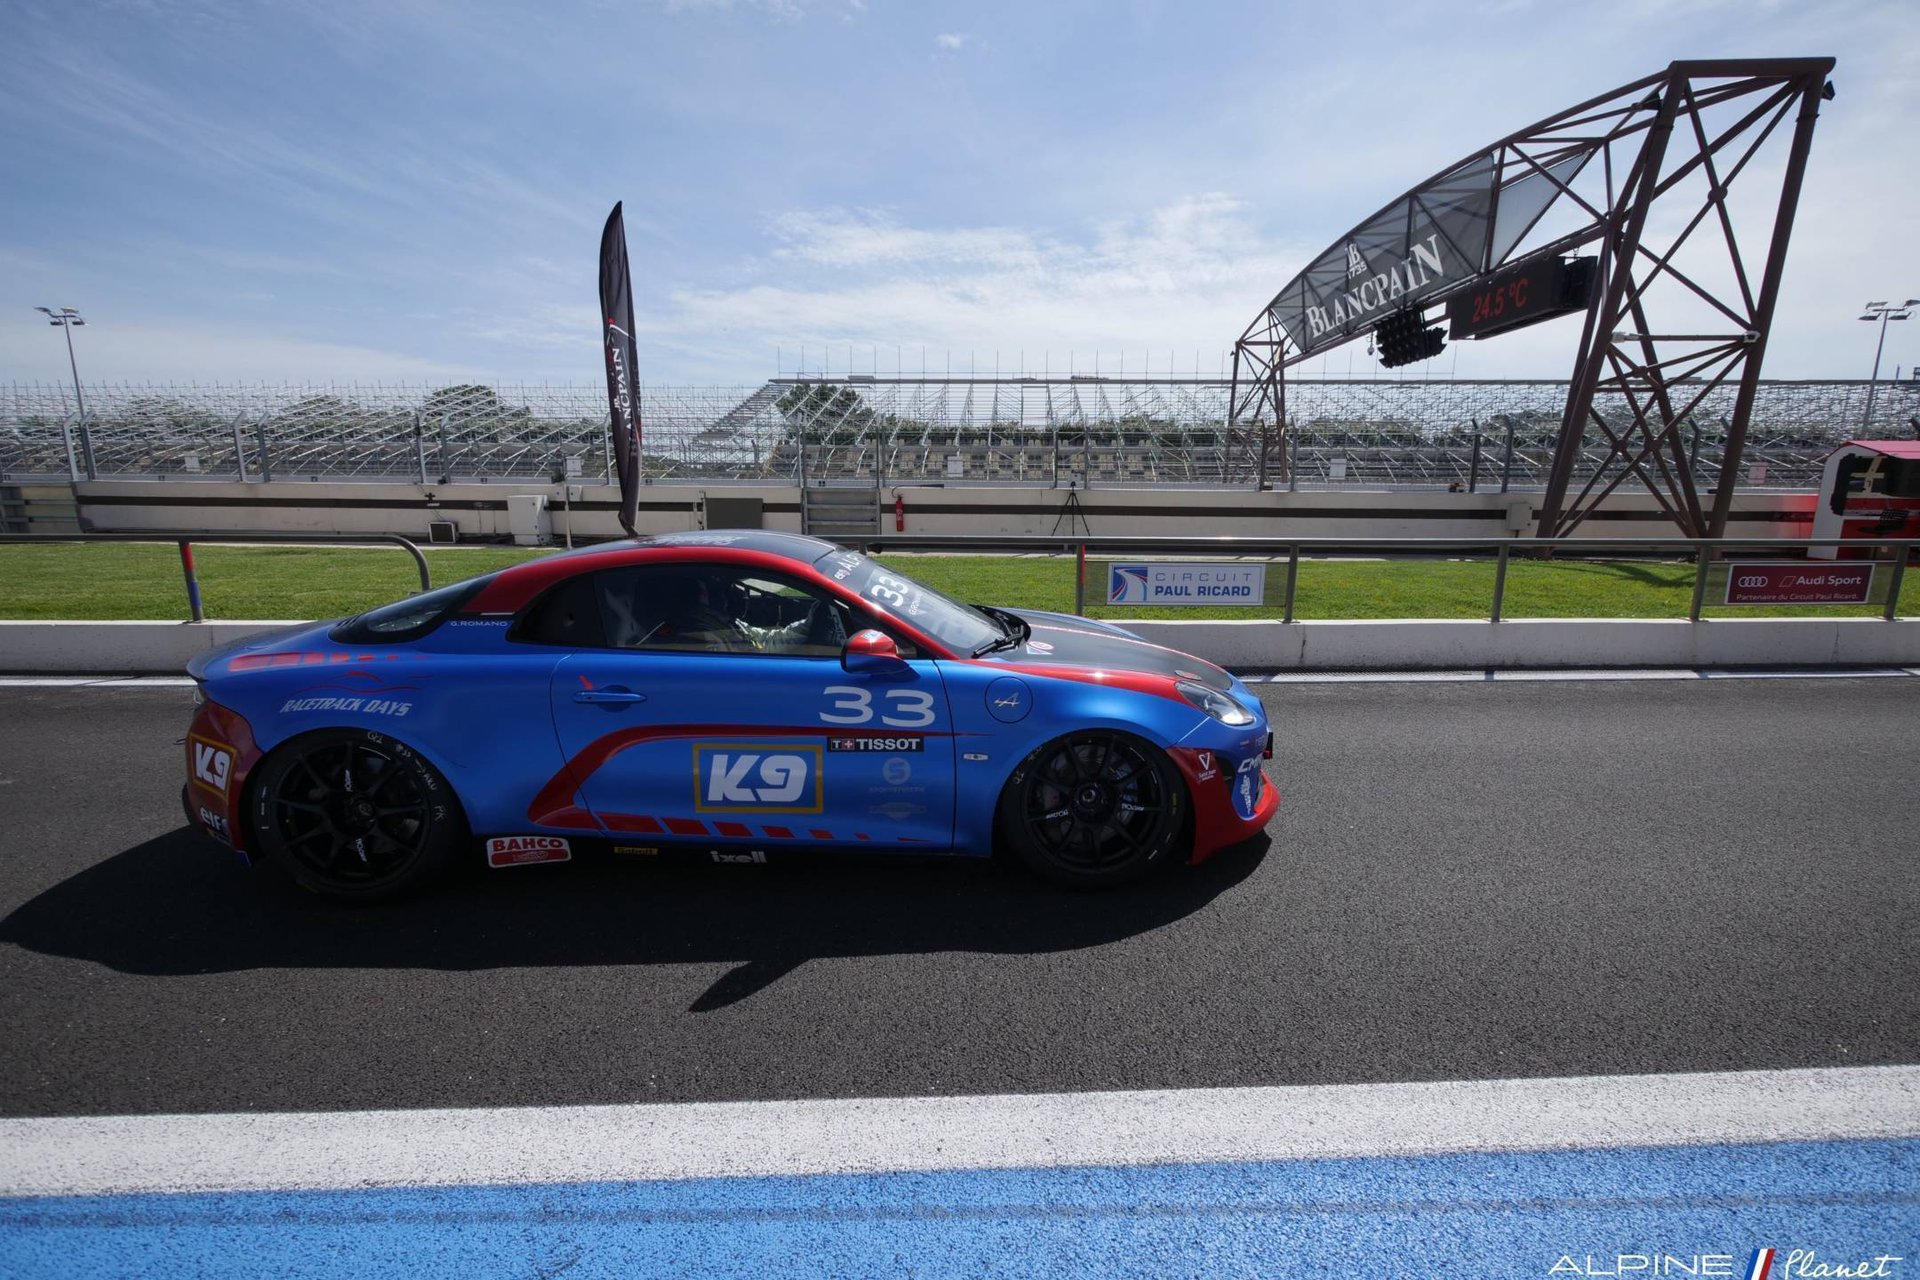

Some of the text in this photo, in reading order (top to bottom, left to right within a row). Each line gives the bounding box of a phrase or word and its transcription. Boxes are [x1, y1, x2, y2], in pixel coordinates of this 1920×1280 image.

[1306, 234, 1445, 338] BLANCPAIN
[1472, 287, 1506, 323] 24.5
[1155, 572, 1253, 582] CIRCUIT
[1796, 575, 1862, 587] Audi Sport
[1154, 585, 1251, 597] PAUL RICARD
[1736, 594, 1777, 602] Partenaire
[1778, 593, 1788, 601] du
[1816, 592, 1832, 601] Paul
[280, 697, 413, 717] RACETRACK DAYS
[819, 686, 936, 728] 33
[856, 738, 921, 751] TISSOT
[195, 741, 231, 791] K9
[707, 754, 808, 802] K9
[200, 806, 222, 831] elf
[492, 838, 563, 851] BAHCO
[710, 850, 767, 863] ixell
